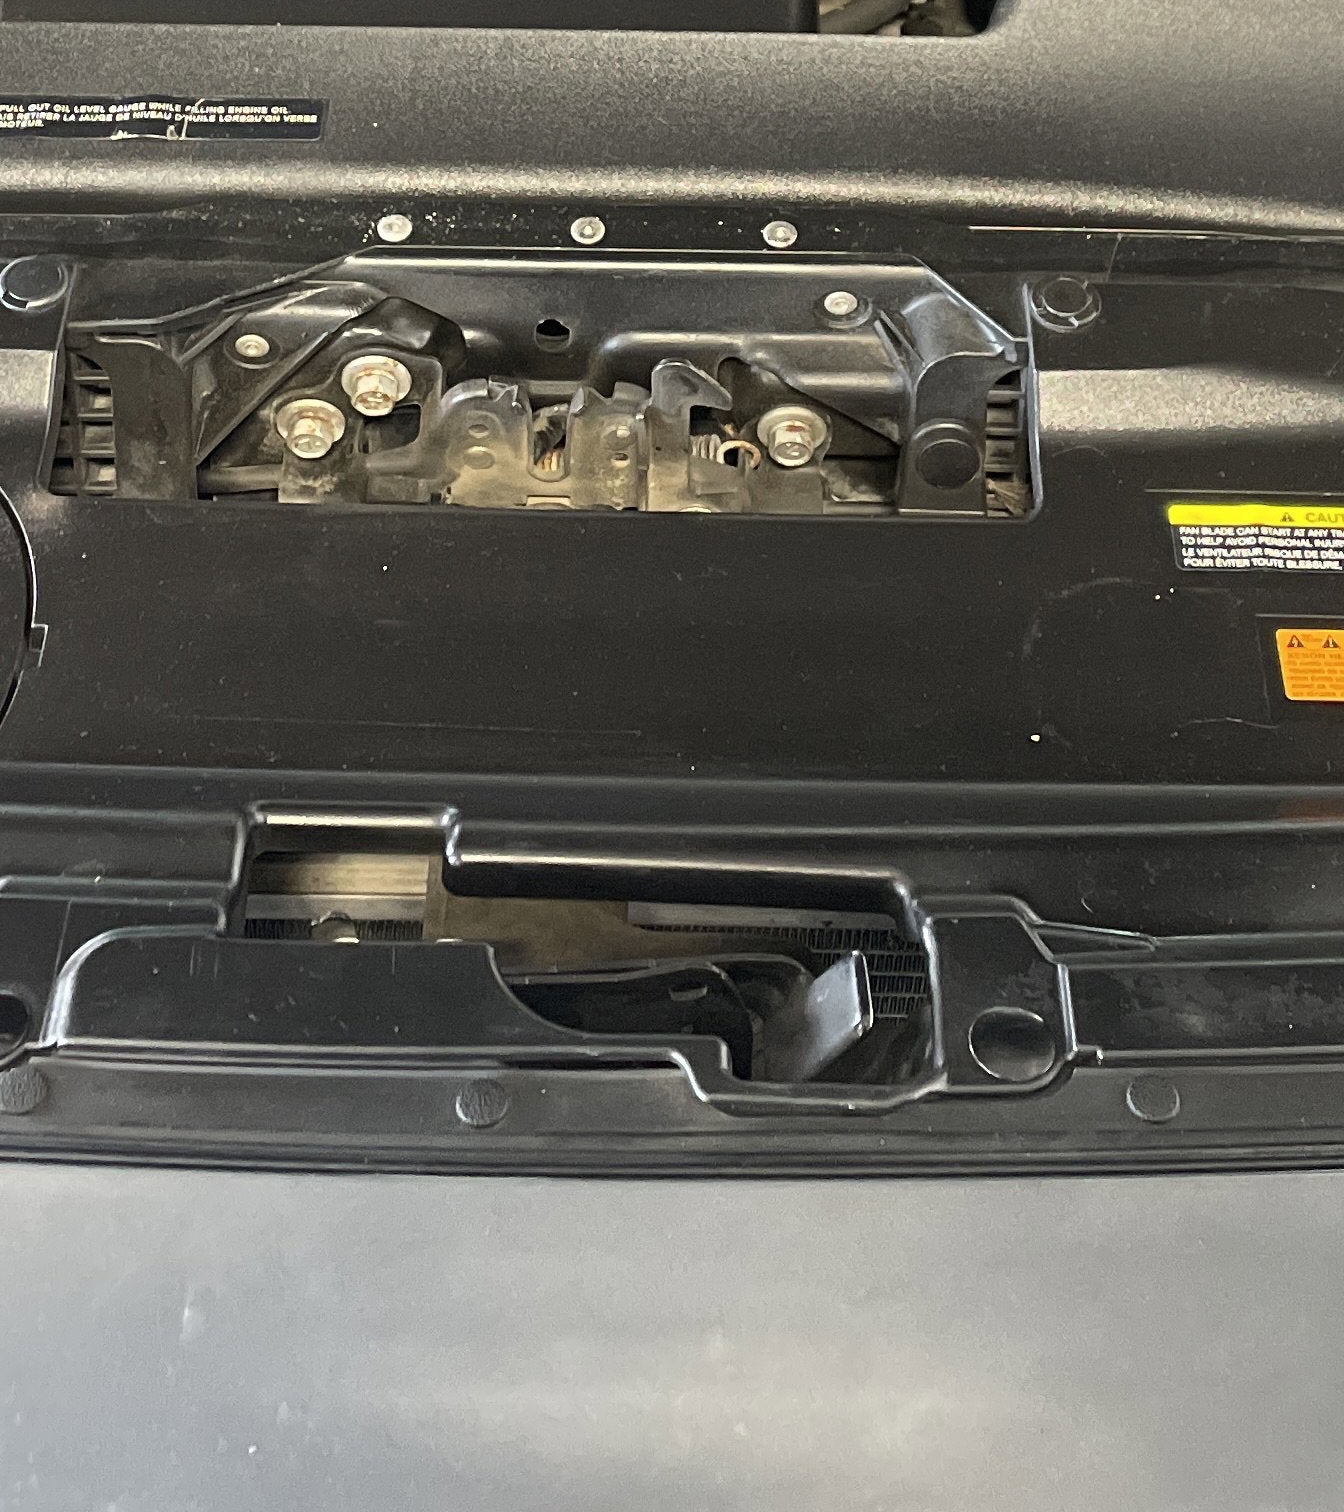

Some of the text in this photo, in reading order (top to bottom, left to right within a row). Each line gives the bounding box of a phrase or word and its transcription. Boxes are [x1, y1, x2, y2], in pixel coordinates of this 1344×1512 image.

[0, 105, 25, 113] PULL
[27, 103, 51, 112] OUT
[73, 105, 106, 113] LEVEL
[149, 102, 182, 112] WHILE
[62, 113, 77, 122] LA
[1236, 527, 1259, 535] CAN
[1260, 527, 1291, 536] START
[1293, 528, 1306, 537] AT
[1180, 536, 1196, 545] TO
[1225, 536, 1257, 546] AVOID
